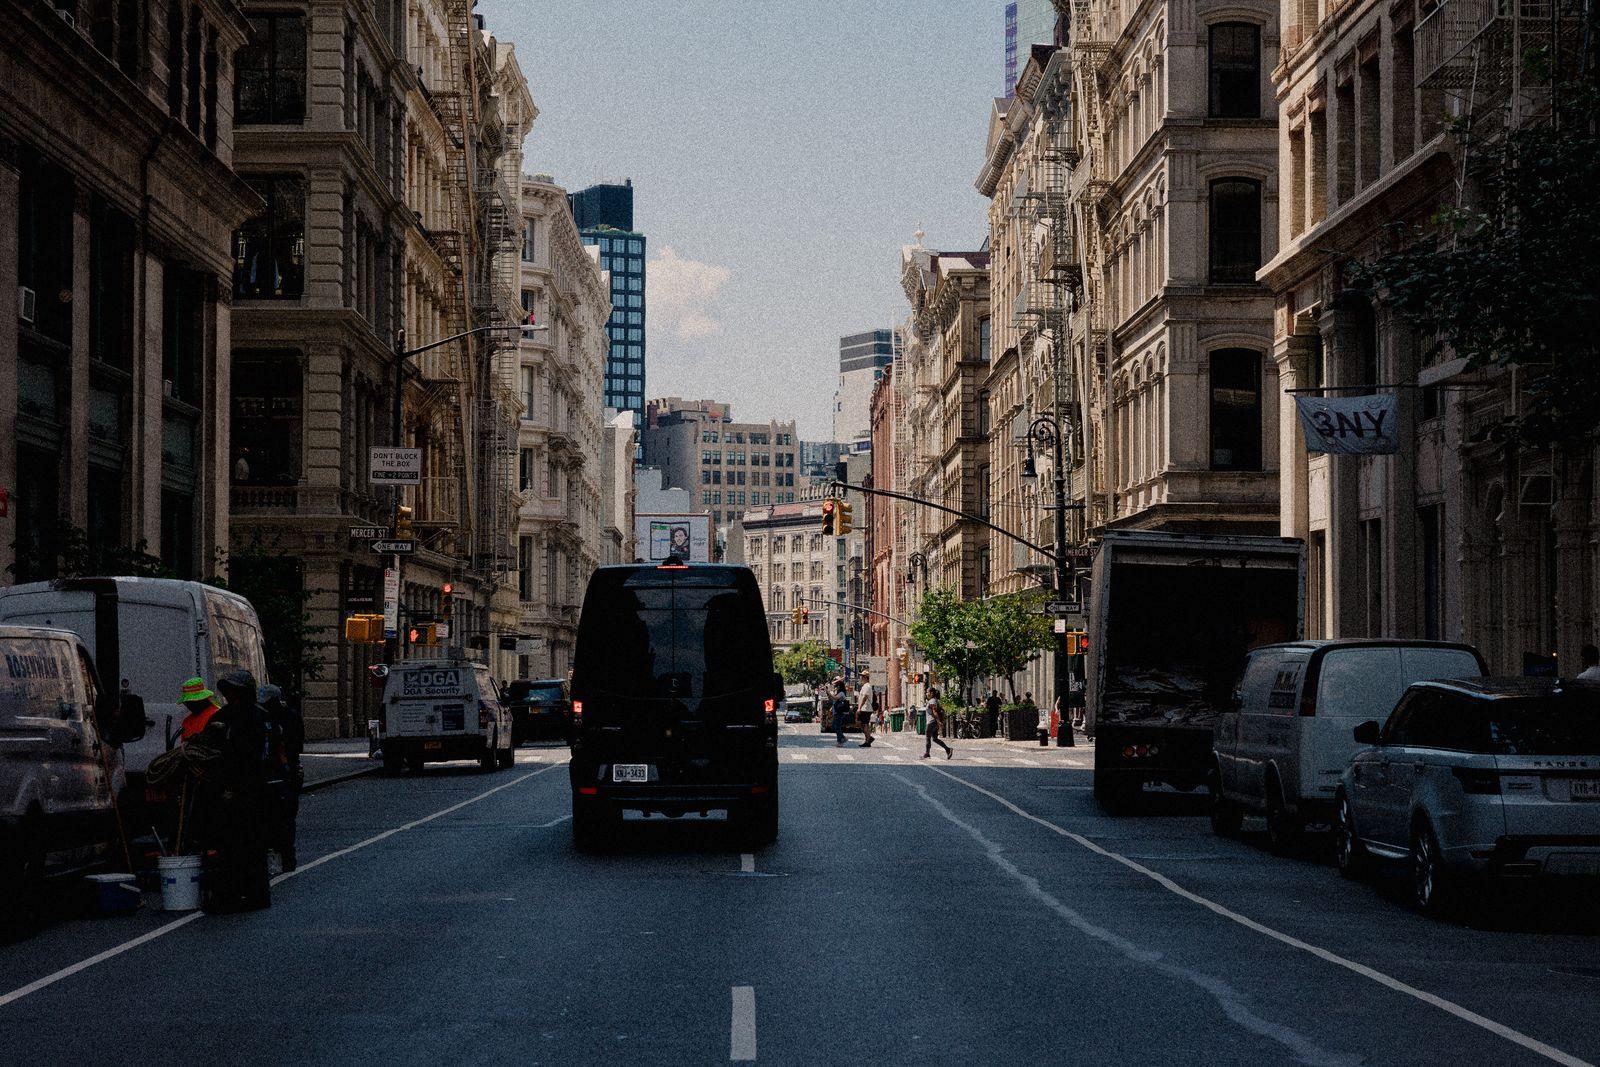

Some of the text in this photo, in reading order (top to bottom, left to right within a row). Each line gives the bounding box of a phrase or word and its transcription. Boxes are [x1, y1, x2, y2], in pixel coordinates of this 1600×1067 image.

[1313, 409, 1387, 438] 3NY
[395, 452, 418, 460] BLOCK
[373, 471, 387, 479] FINE
[398, 471, 418, 479] POINTS
[350, 528, 386, 538] MERCER ST
[1067, 548, 1089, 557] MERCER
[420, 671, 459, 686] DGA
[403, 686, 460, 696] DGA Security
